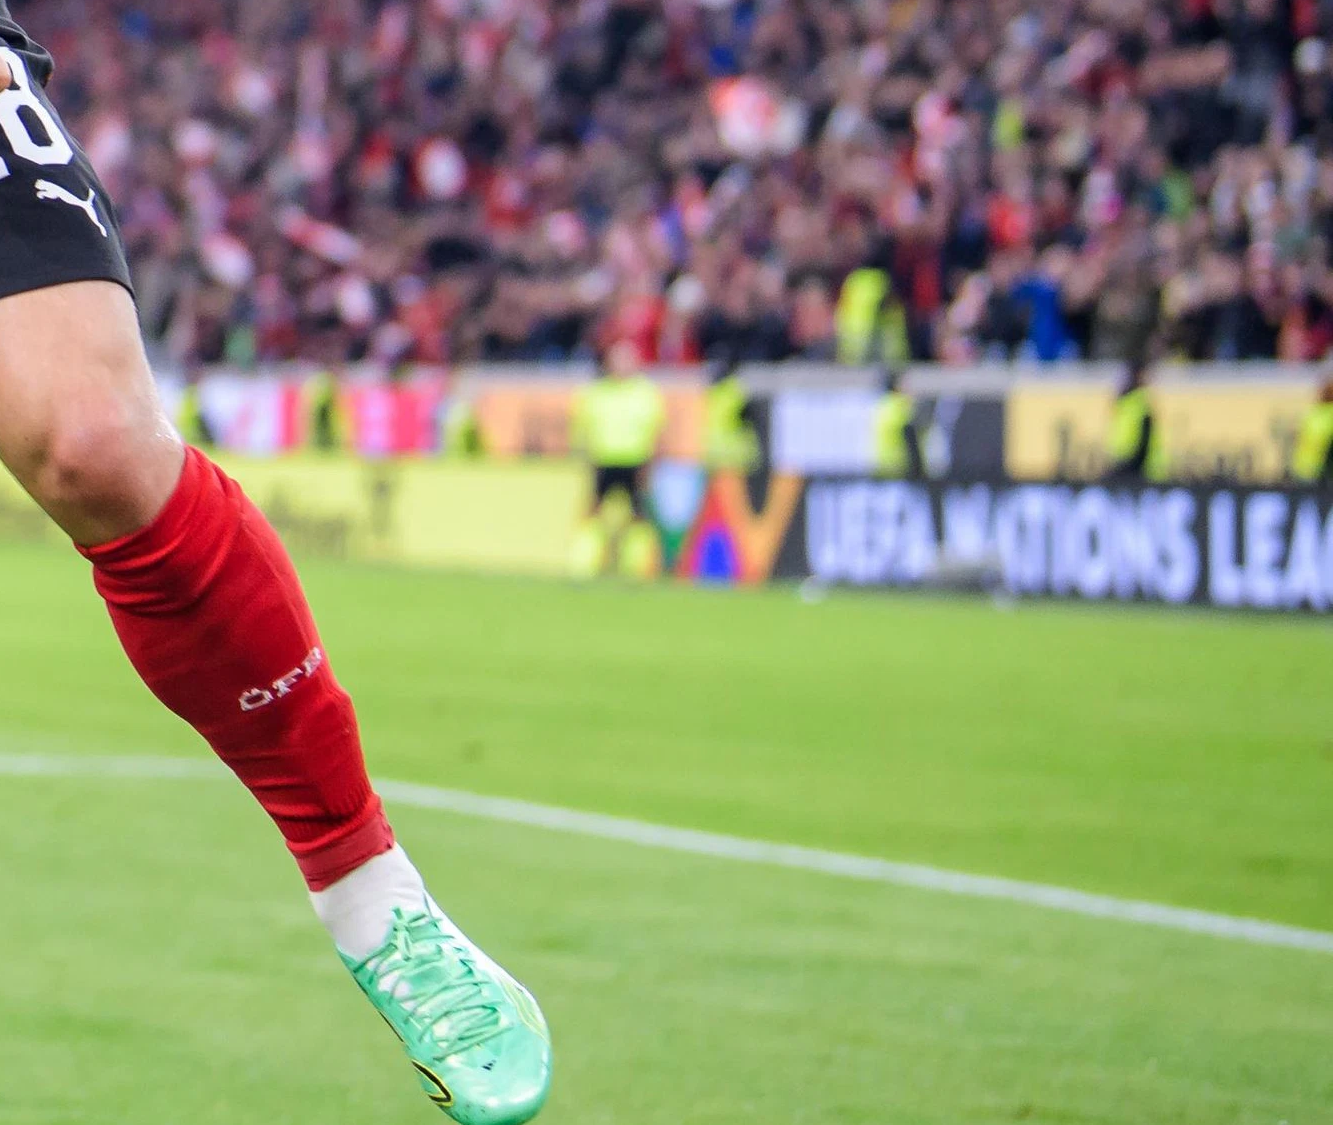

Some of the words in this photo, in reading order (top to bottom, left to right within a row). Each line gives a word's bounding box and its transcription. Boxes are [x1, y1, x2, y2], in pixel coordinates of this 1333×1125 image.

[806, 479, 932, 581] UEFA
[941, 483, 1201, 603] NATIONS
[1208, 488, 1333, 611] LEA
[238, 646, 322, 711] ÖFB
